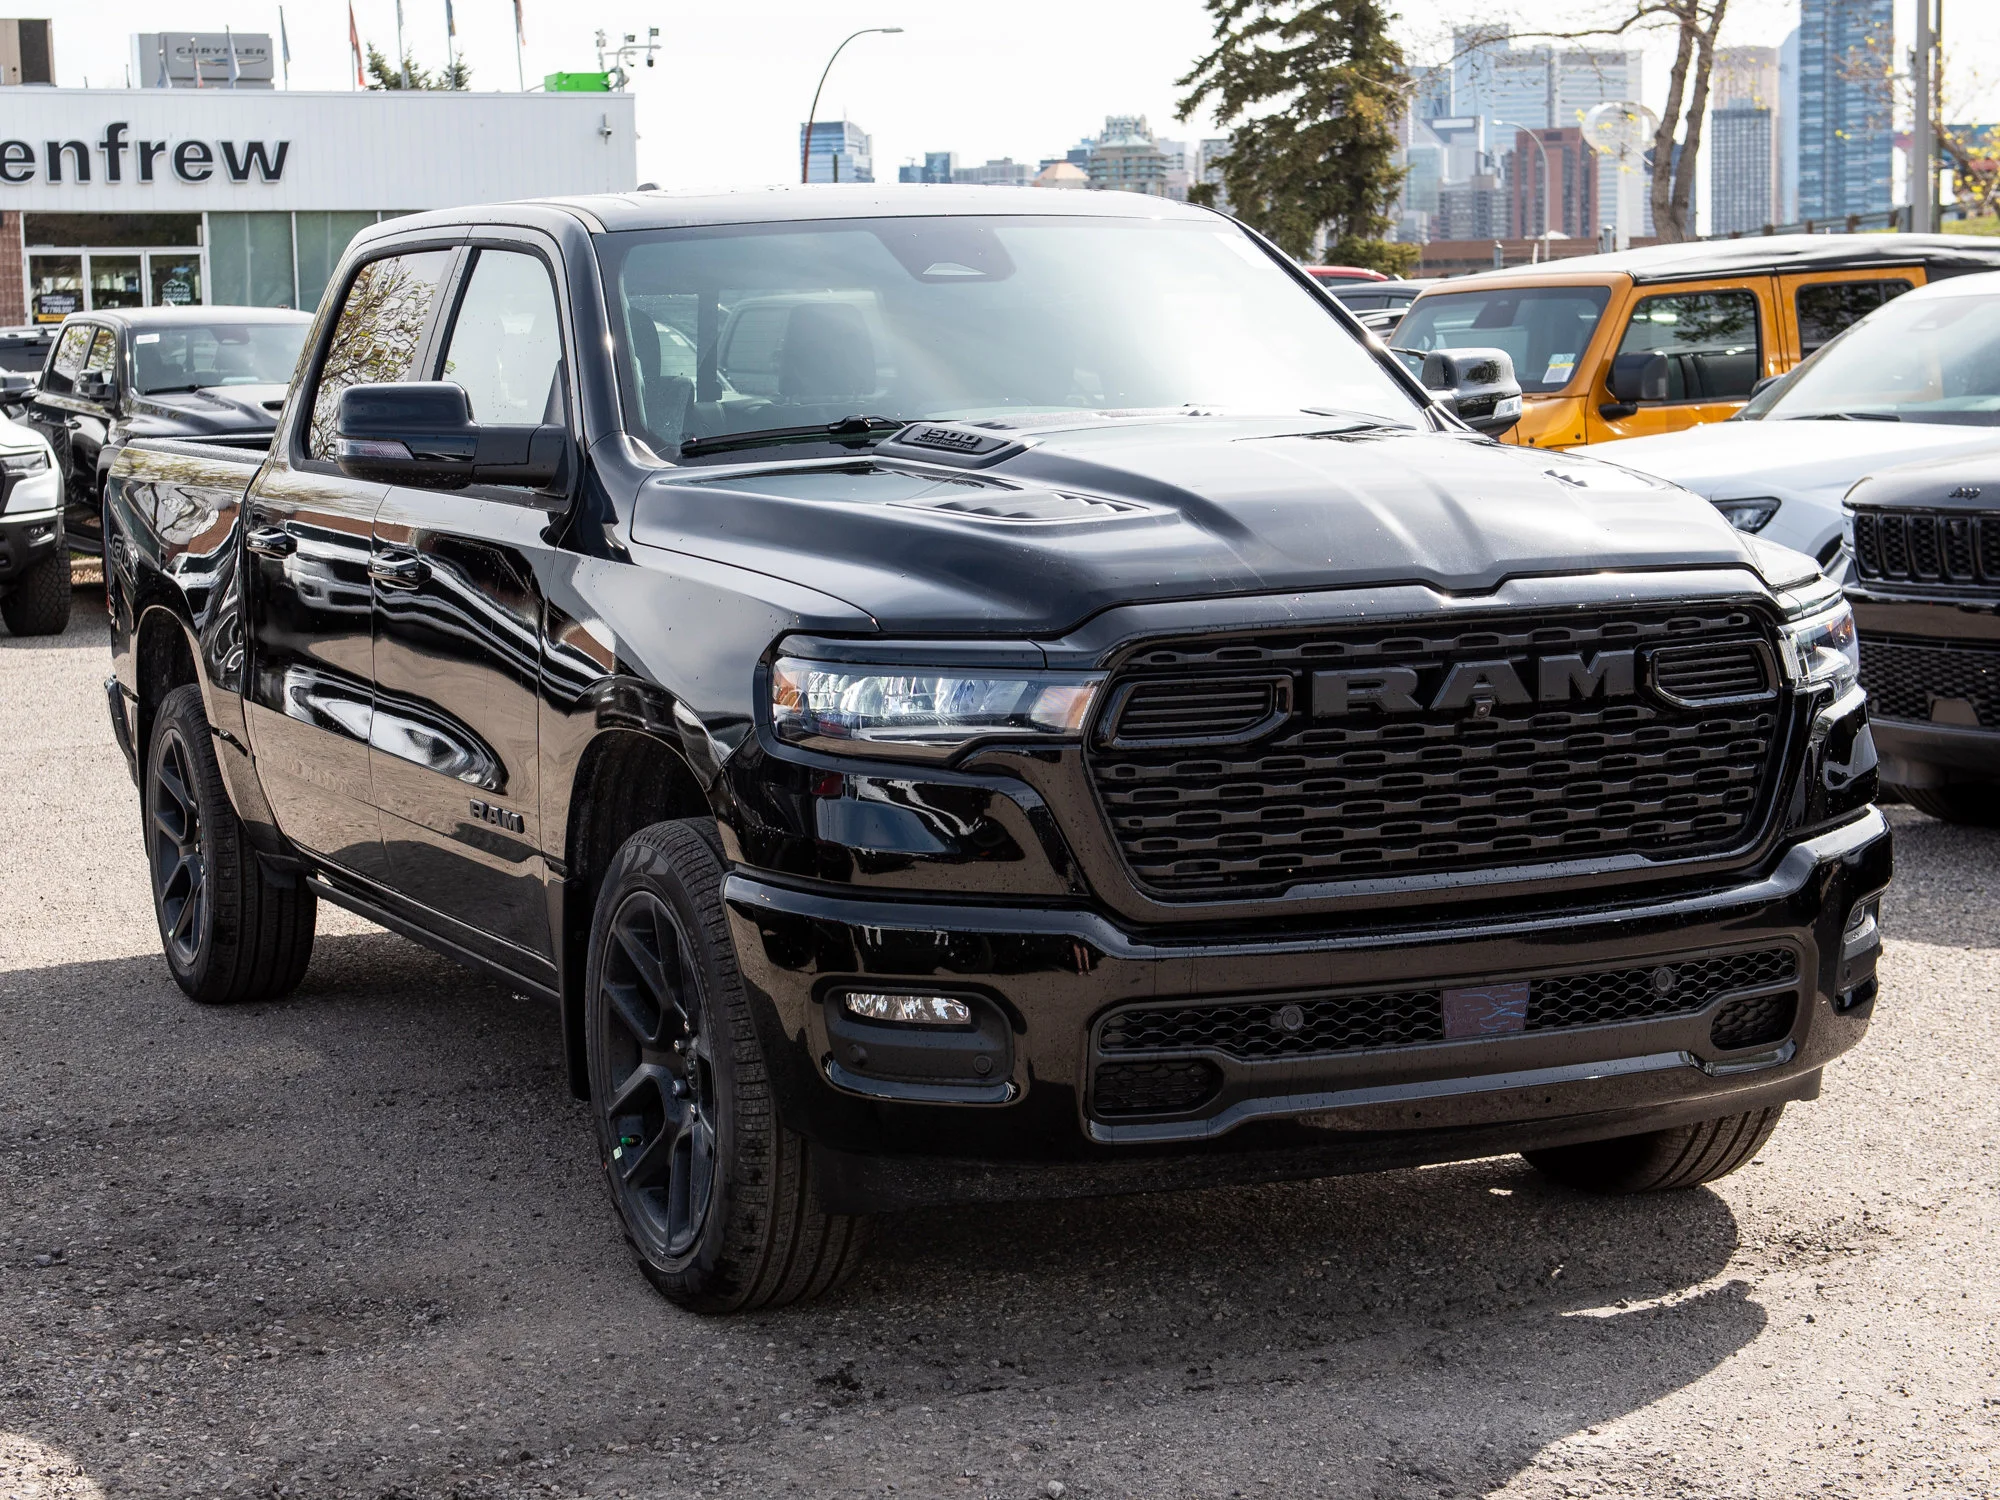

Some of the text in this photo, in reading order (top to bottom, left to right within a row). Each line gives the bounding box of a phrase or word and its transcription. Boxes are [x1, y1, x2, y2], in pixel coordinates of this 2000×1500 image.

[0, 121, 290, 183] enfrew
[920, 428, 983, 445] 1500
[1312, 650, 1636, 718] RAM
[469, 798, 525, 835] RAM
